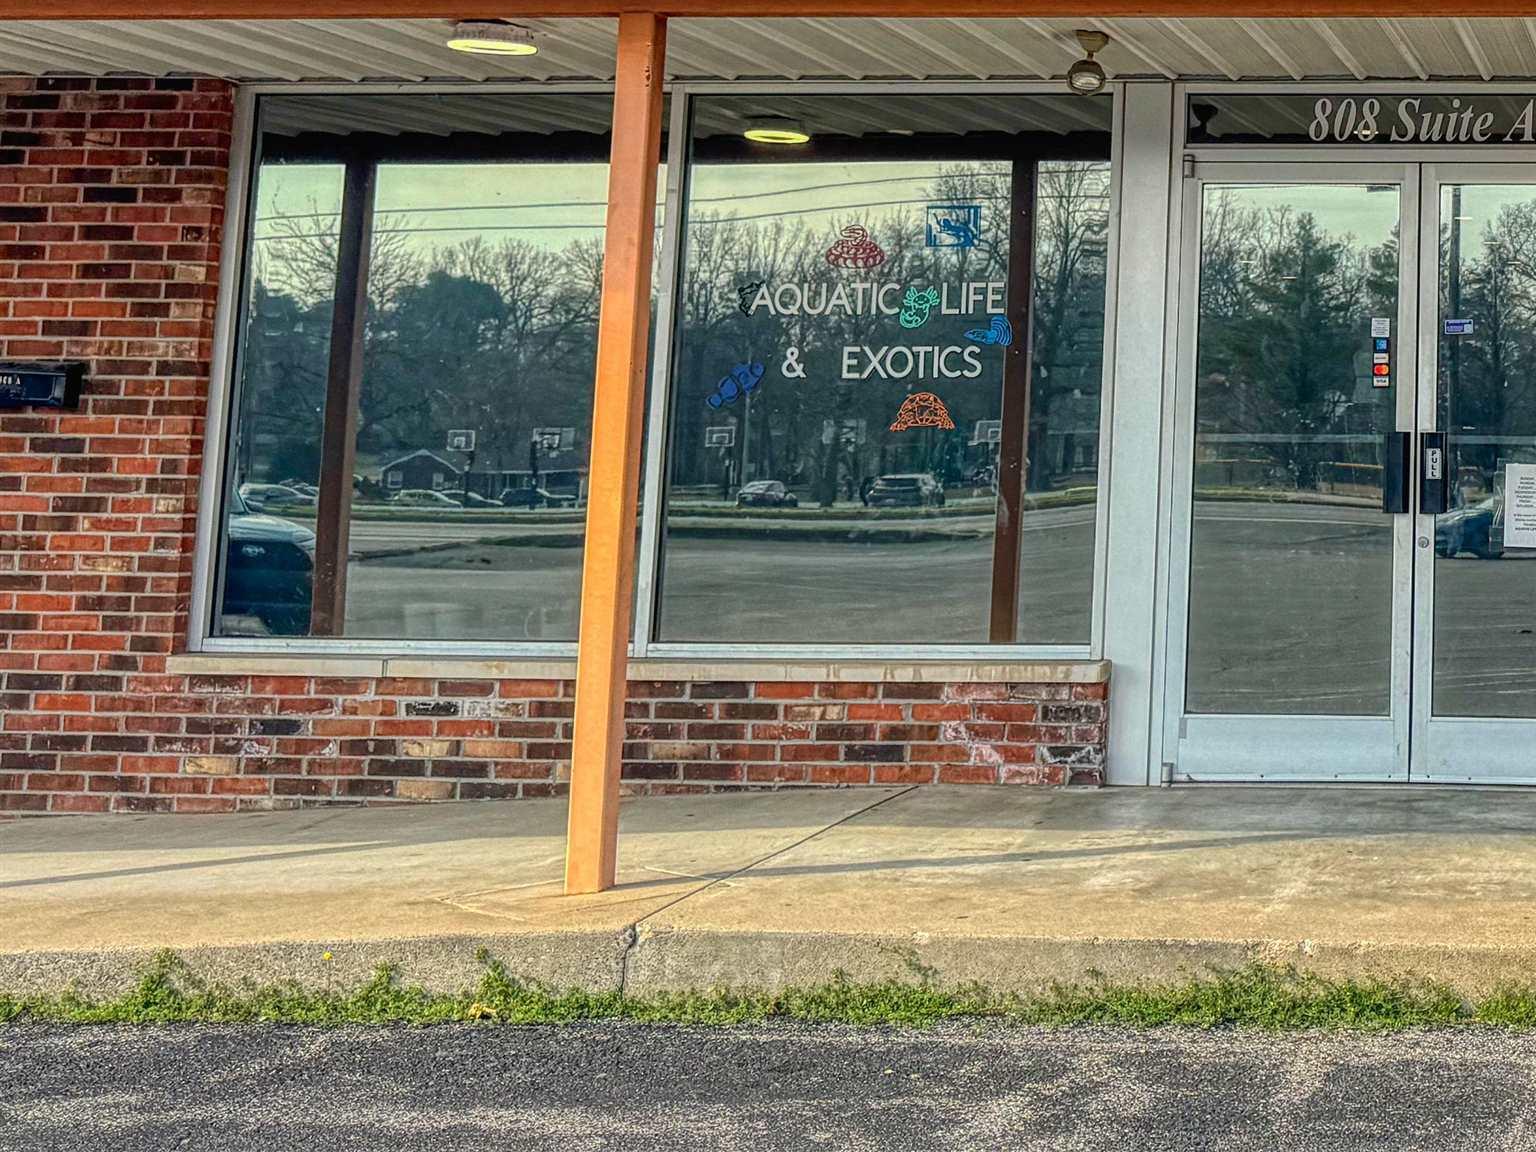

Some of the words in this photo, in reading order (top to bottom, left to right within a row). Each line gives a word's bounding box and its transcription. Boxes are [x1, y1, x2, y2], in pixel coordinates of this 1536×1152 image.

[1309, 98, 1381, 142] 808
[1390, 98, 1495, 142] Suite
[1502, 98, 1536, 142] A
[750, 282, 900, 316] AQUATIC
[941, 281, 1005, 315] LIFE
[780, 346, 807, 378] &
[841, 345, 983, 380] EXOTICS
